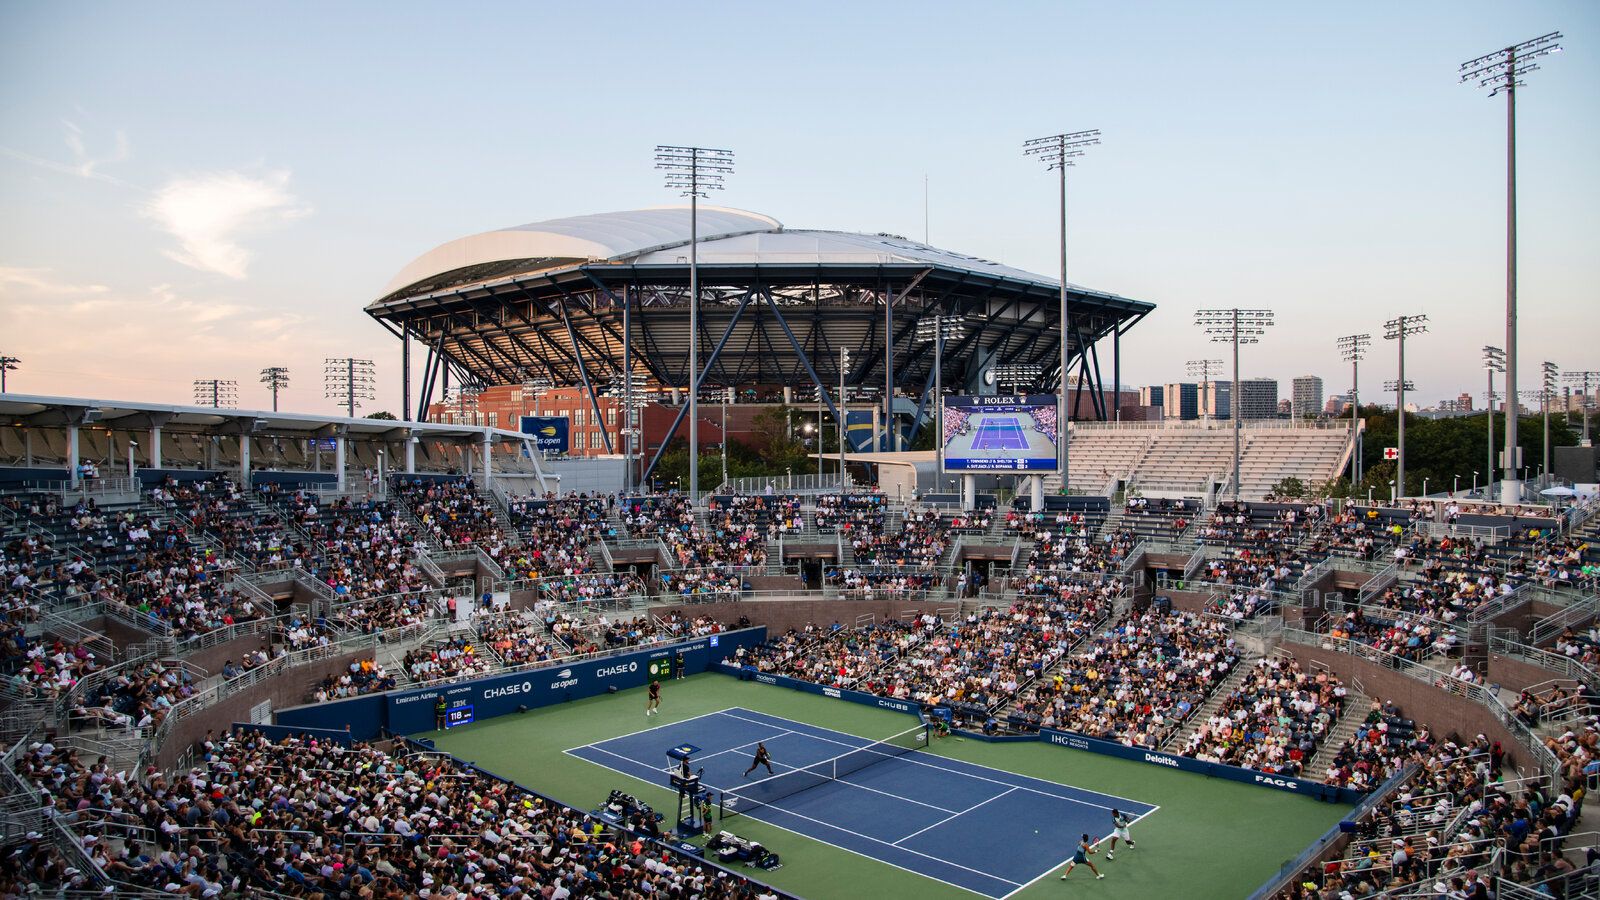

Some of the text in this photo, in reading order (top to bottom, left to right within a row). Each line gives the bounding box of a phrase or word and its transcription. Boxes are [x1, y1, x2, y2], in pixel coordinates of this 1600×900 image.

[544, 438, 561, 446] open
[596, 664, 628, 678] CHASE
[560, 678, 578, 688] open
[484, 684, 521, 699] CHASE
[395, 692, 438, 705] Emirates Airline
[453, 699, 466, 708] IBM
[878, 700, 908, 711] CHUBB
[450, 711, 462, 720] 118
[1052, 734, 1069, 745] IHG
[1145, 753, 1179, 767] Deloitte.
